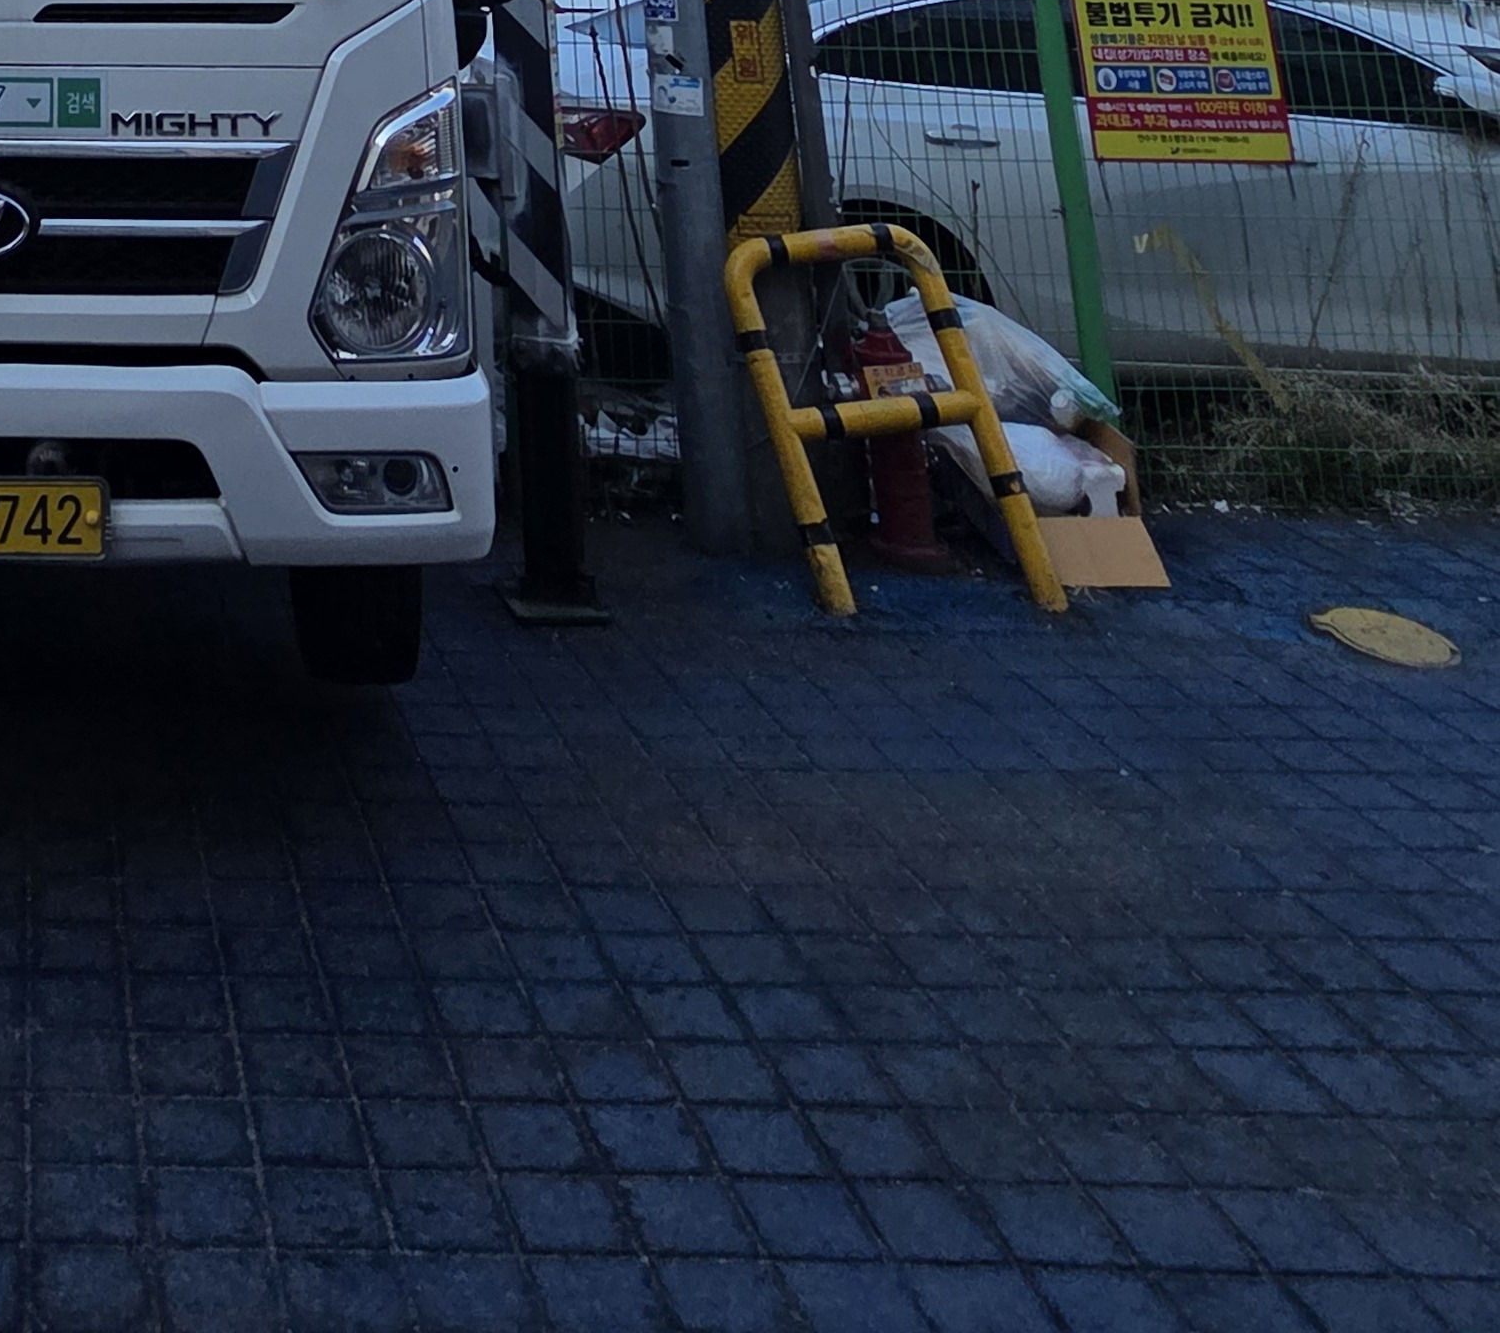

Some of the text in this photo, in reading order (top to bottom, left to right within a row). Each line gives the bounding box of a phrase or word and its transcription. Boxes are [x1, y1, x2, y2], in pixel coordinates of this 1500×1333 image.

[1085, 1, 1255, 28] 불법투기 금지!!
[65, 92, 96, 115] 검색
[110, 110, 283, 137] MIGHTY
